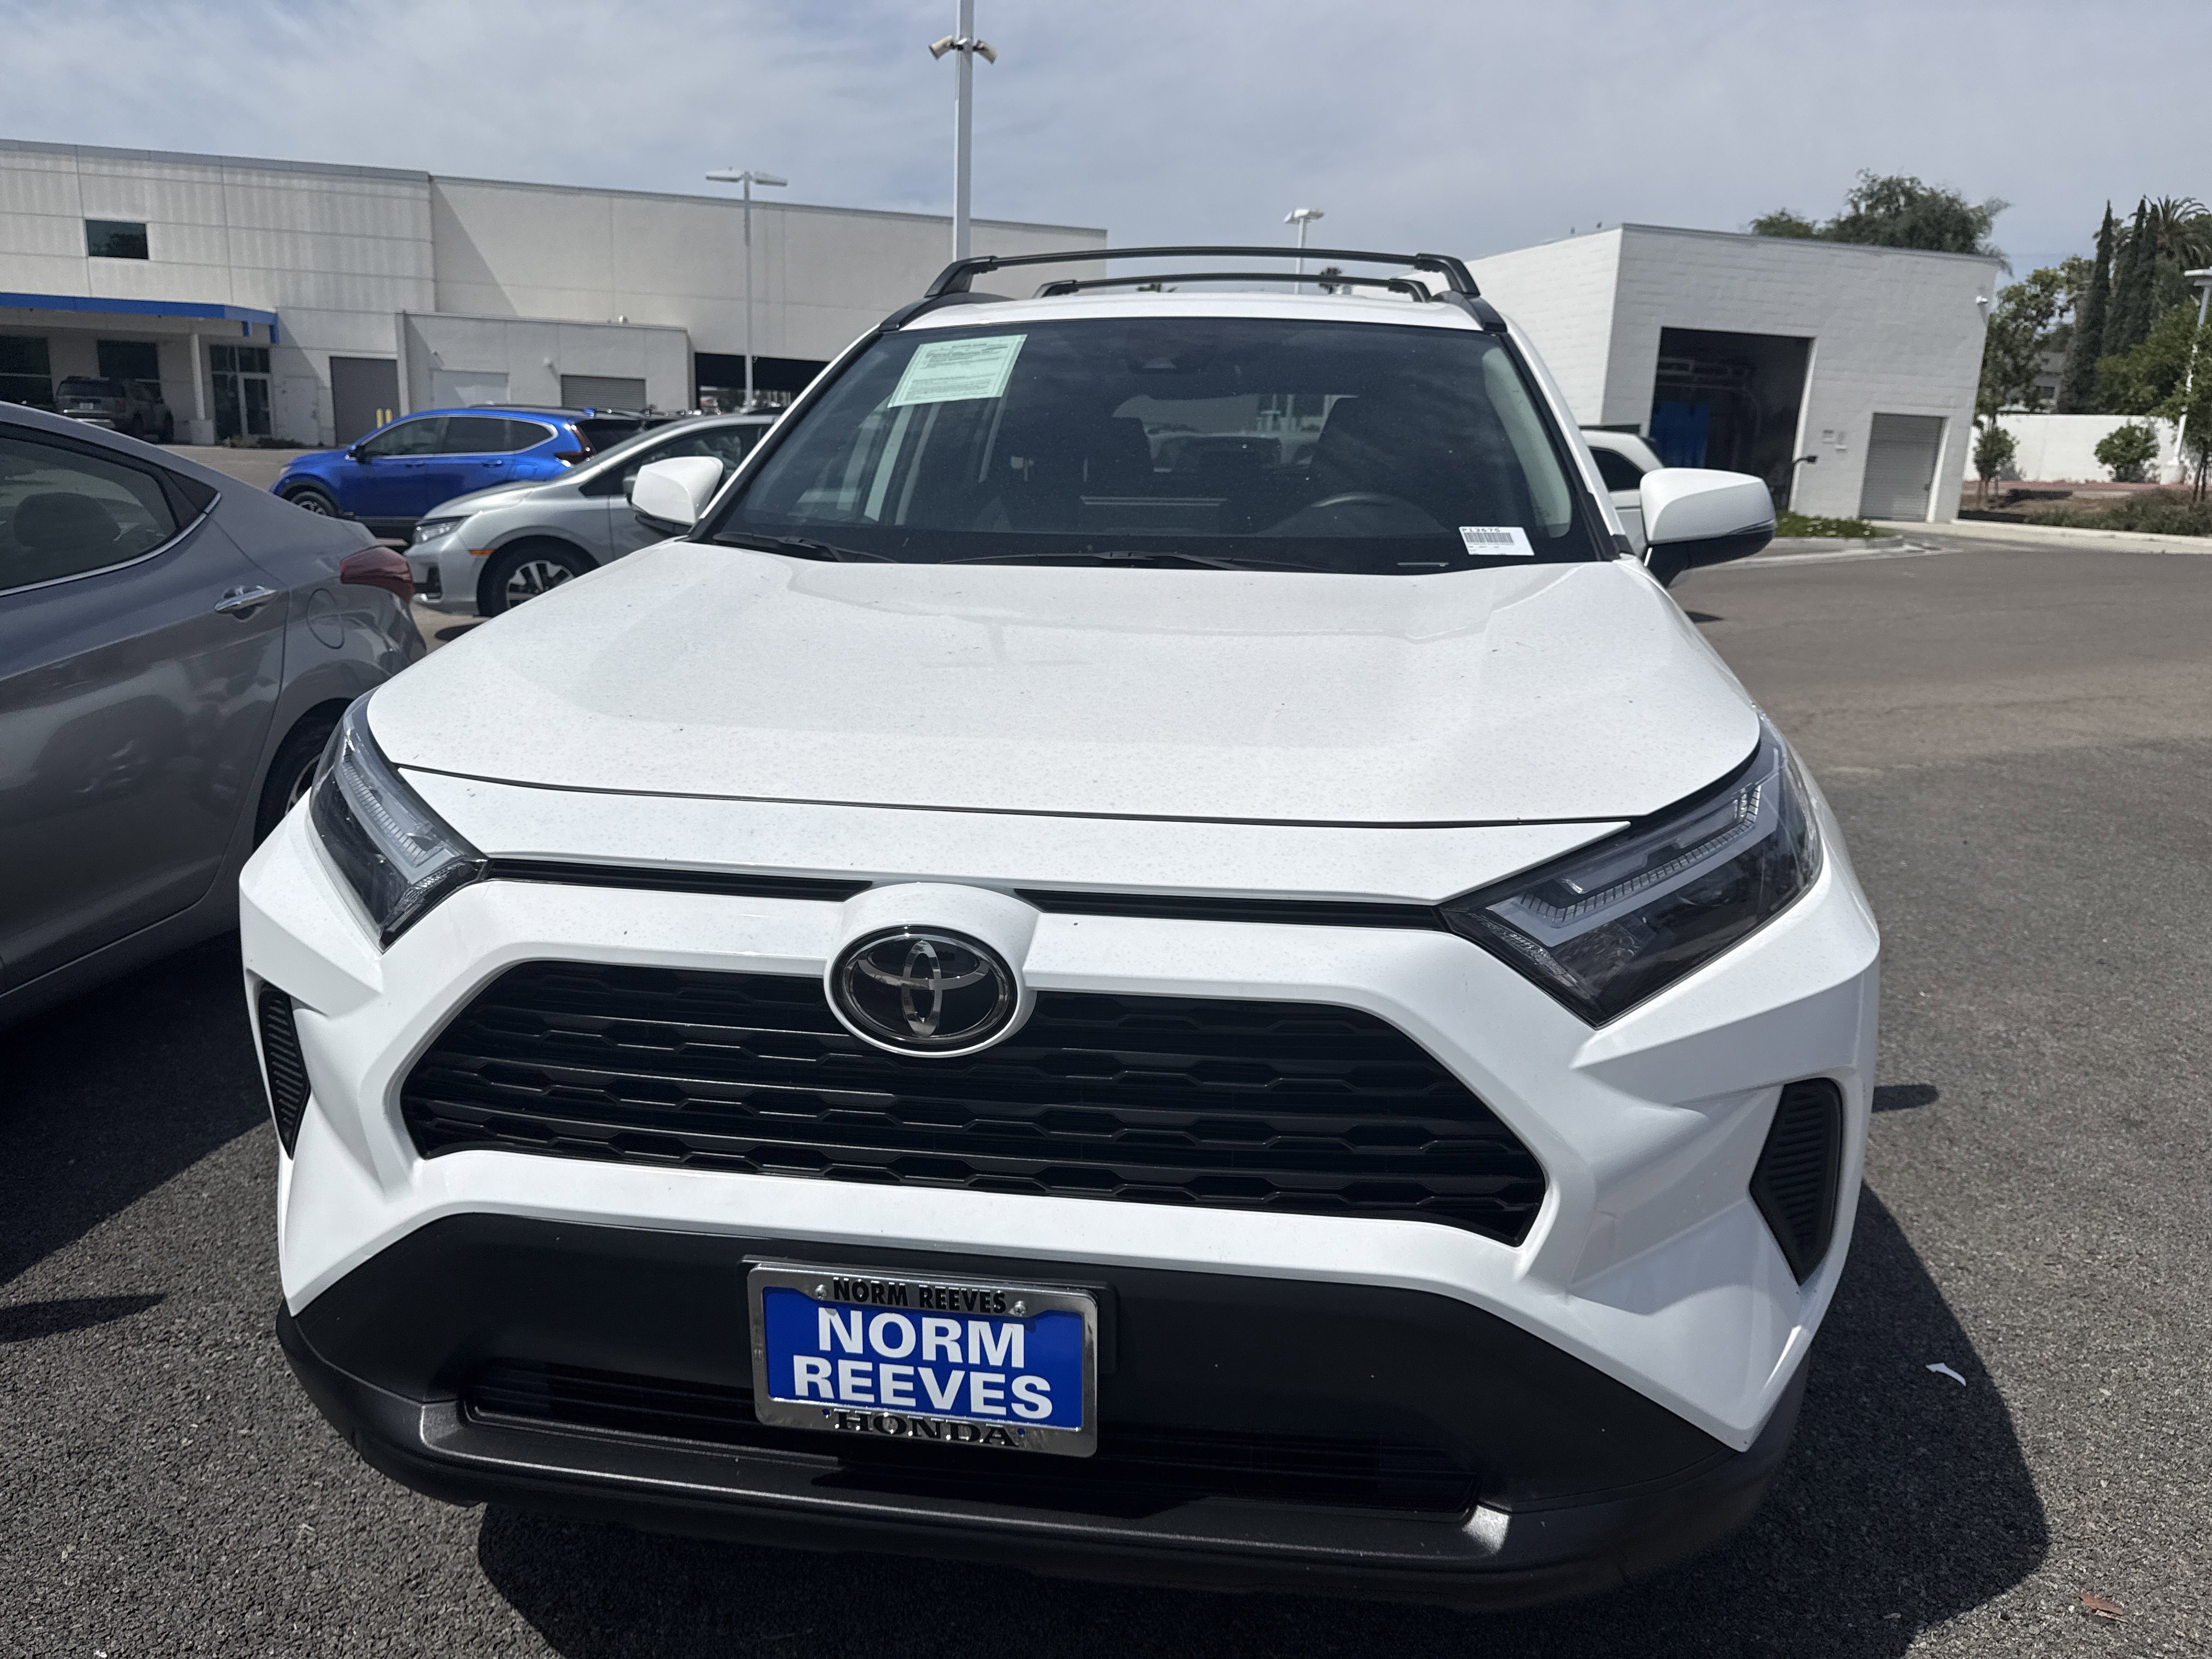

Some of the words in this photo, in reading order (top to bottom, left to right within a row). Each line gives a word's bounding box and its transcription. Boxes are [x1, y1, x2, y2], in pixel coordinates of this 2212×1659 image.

[833, 1276, 909, 1306] NORM
[918, 1284, 1007, 1314] REEVES
[818, 1307, 1025, 1369] NORM
[793, 1355, 1053, 1419] REEVES
[833, 1408, 1019, 1447] HONDA
